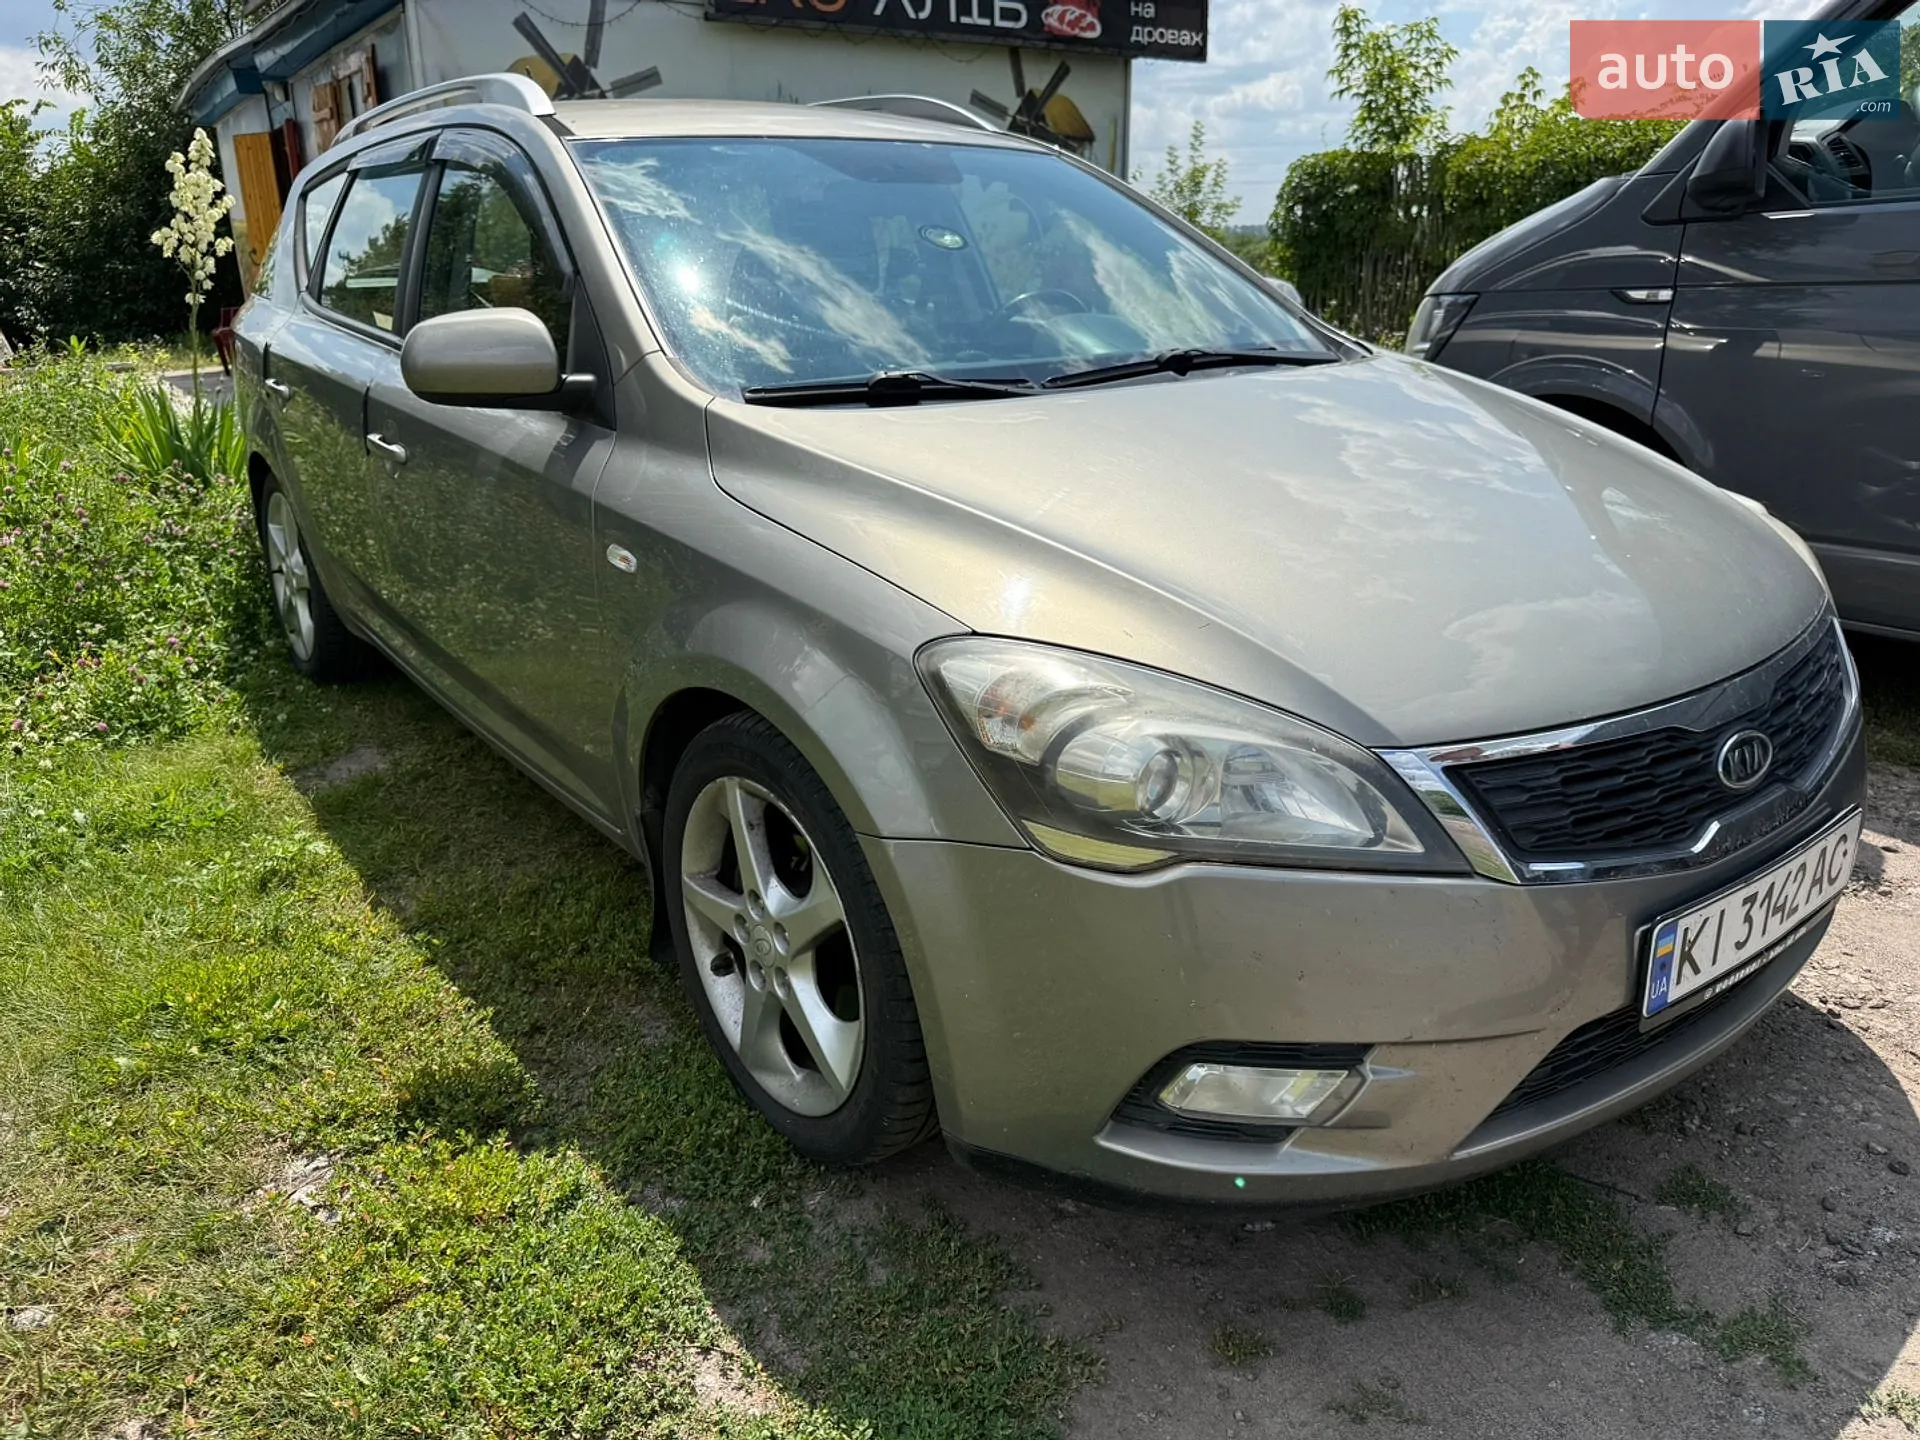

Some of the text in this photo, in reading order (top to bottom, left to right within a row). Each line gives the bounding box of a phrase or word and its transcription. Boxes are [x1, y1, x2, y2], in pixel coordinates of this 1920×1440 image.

[1130, 1, 1155, 18] на
[1130, 25, 1204, 46] дровах
[1676, 908, 1726, 986] KI
[1734, 861, 1807, 951] 3142
[1806, 833, 1848, 904] AC
[1651, 976, 1667, 999] UA
